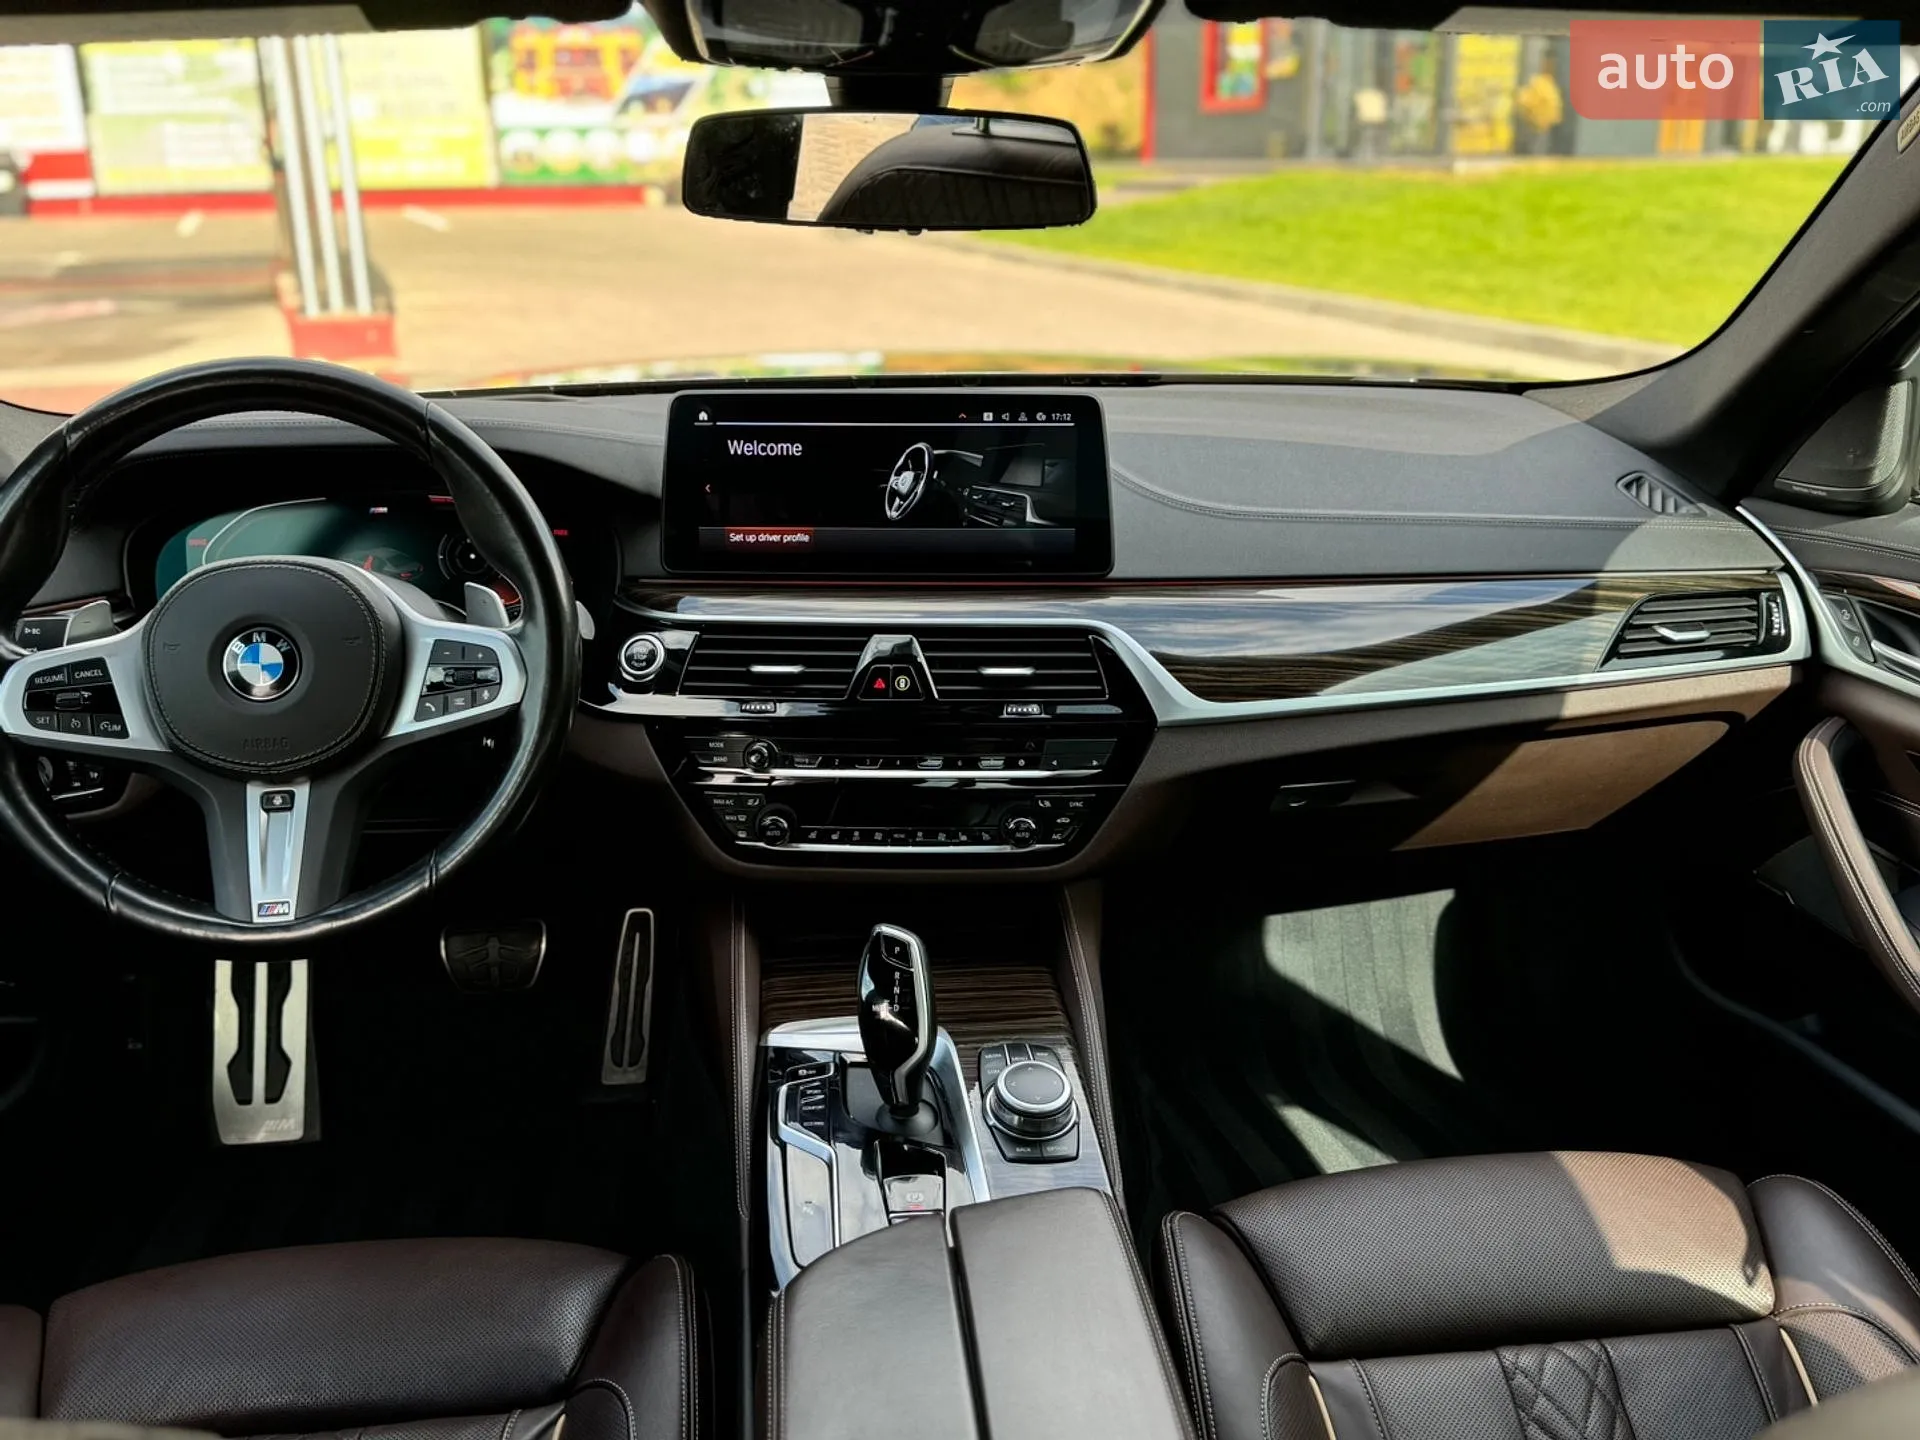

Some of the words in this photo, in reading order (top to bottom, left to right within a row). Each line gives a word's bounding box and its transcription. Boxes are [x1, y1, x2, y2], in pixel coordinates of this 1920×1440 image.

[1051, 412, 1072, 421] 17:12
[727, 439, 803, 456] Welcome
[729, 532, 744, 543] Set
[745, 534, 757, 544] up
[758, 532, 781, 543] driver
[782, 532, 810, 544] profile
[34, 673, 65, 685] RESUME
[74, 669, 104, 680] CANCEL
[36, 716, 51, 725] SET
[241, 736, 290, 750] AIRBAG
[893, 1003, 900, 1012] D
